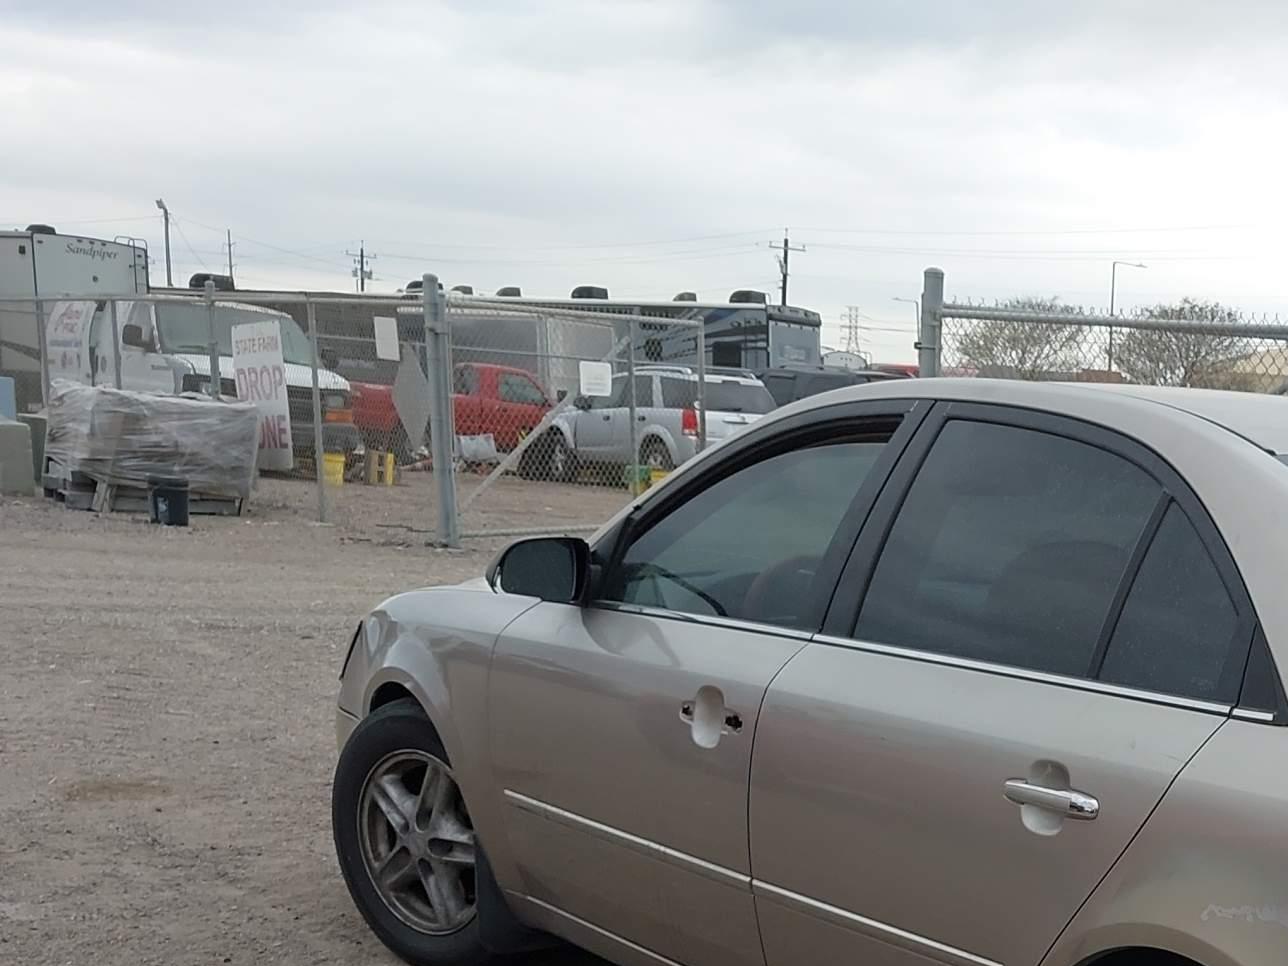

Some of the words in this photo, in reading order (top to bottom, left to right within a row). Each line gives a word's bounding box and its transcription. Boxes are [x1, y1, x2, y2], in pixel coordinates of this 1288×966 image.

[64, 243, 119, 261] Sandpiper
[235, 338, 257, 355] STATE
[257, 335, 279, 353] FARM
[237, 364, 283, 400] DROP
